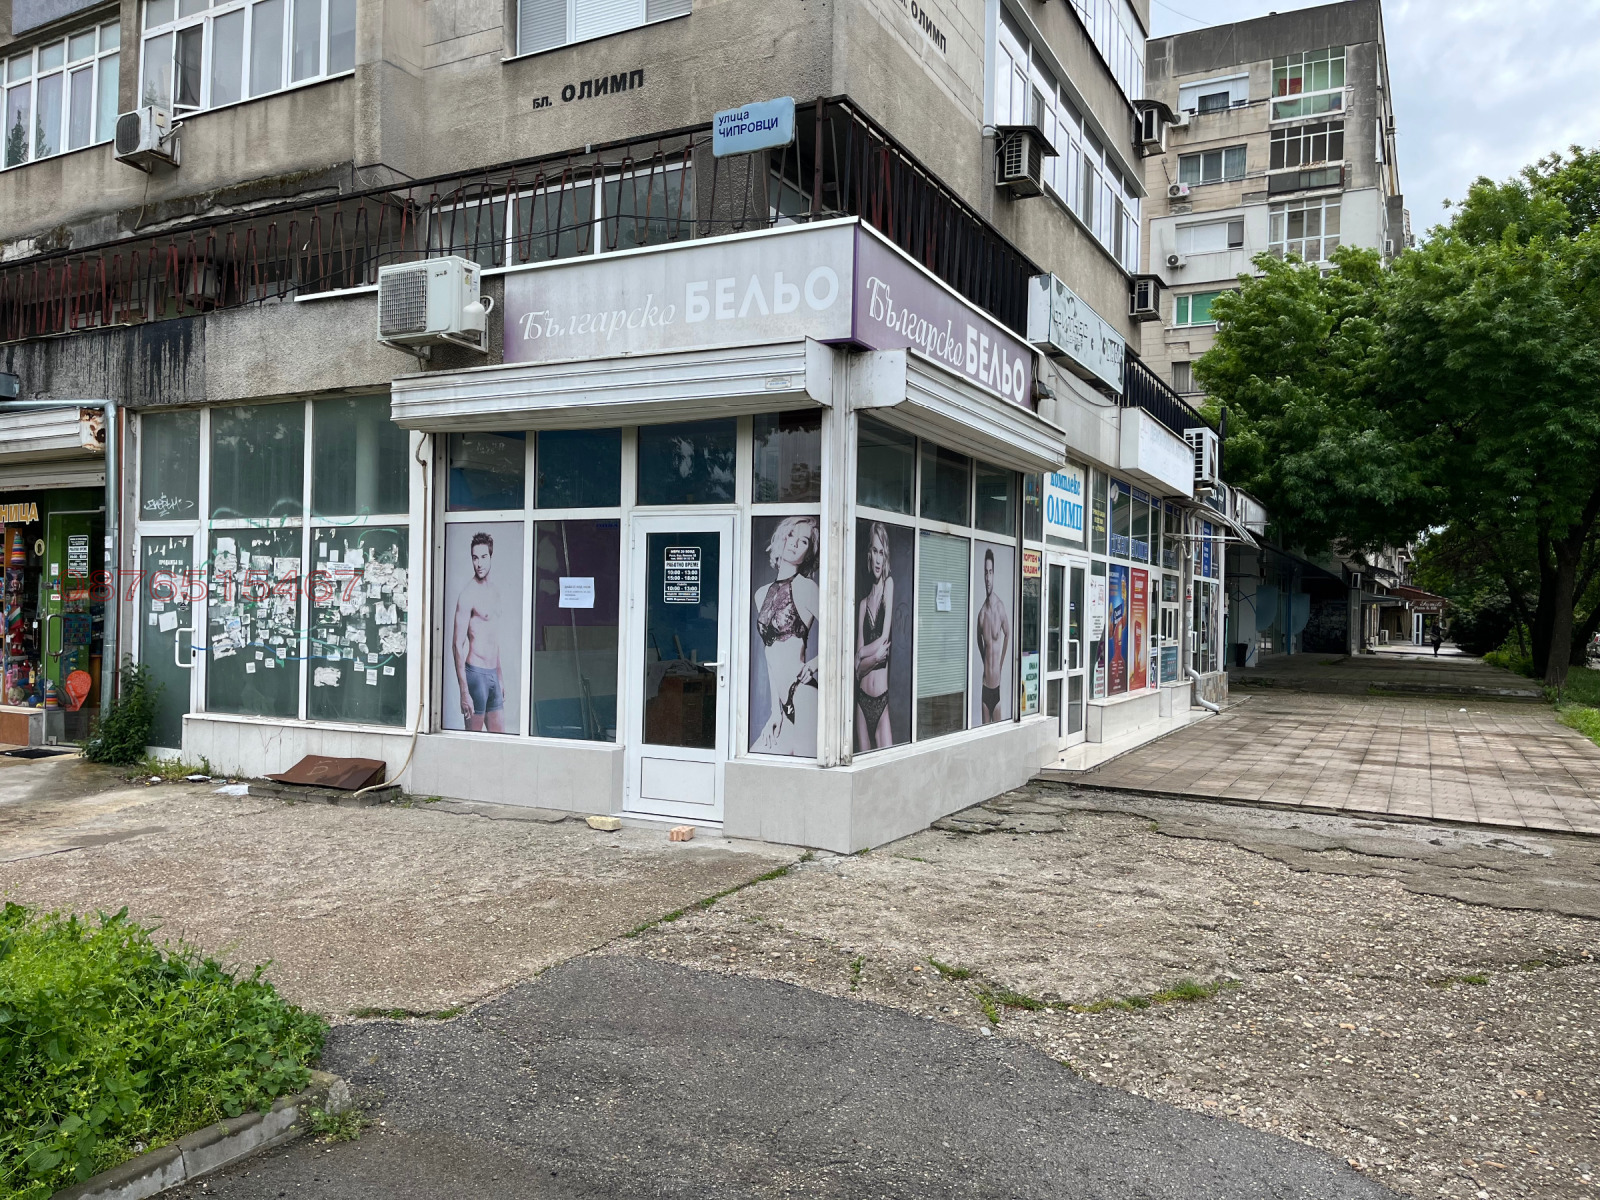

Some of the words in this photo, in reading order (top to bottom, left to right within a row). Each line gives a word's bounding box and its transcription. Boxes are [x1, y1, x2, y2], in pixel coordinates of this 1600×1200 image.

[911, 0, 946, 54] ОЛИМП
[561, 69, 644, 102] ОЛИМП
[718, 111, 749, 126] улица
[719, 117, 778, 138] ЧИПРОВЦИ
[519, 294, 676, 341] Българско
[685, 266, 839, 323] БЕЛЬО
[866, 276, 964, 367] Българско
[966, 324, 1025, 403] БЕЛЬО
[1047, 494, 1083, 531] ОЛИМП
